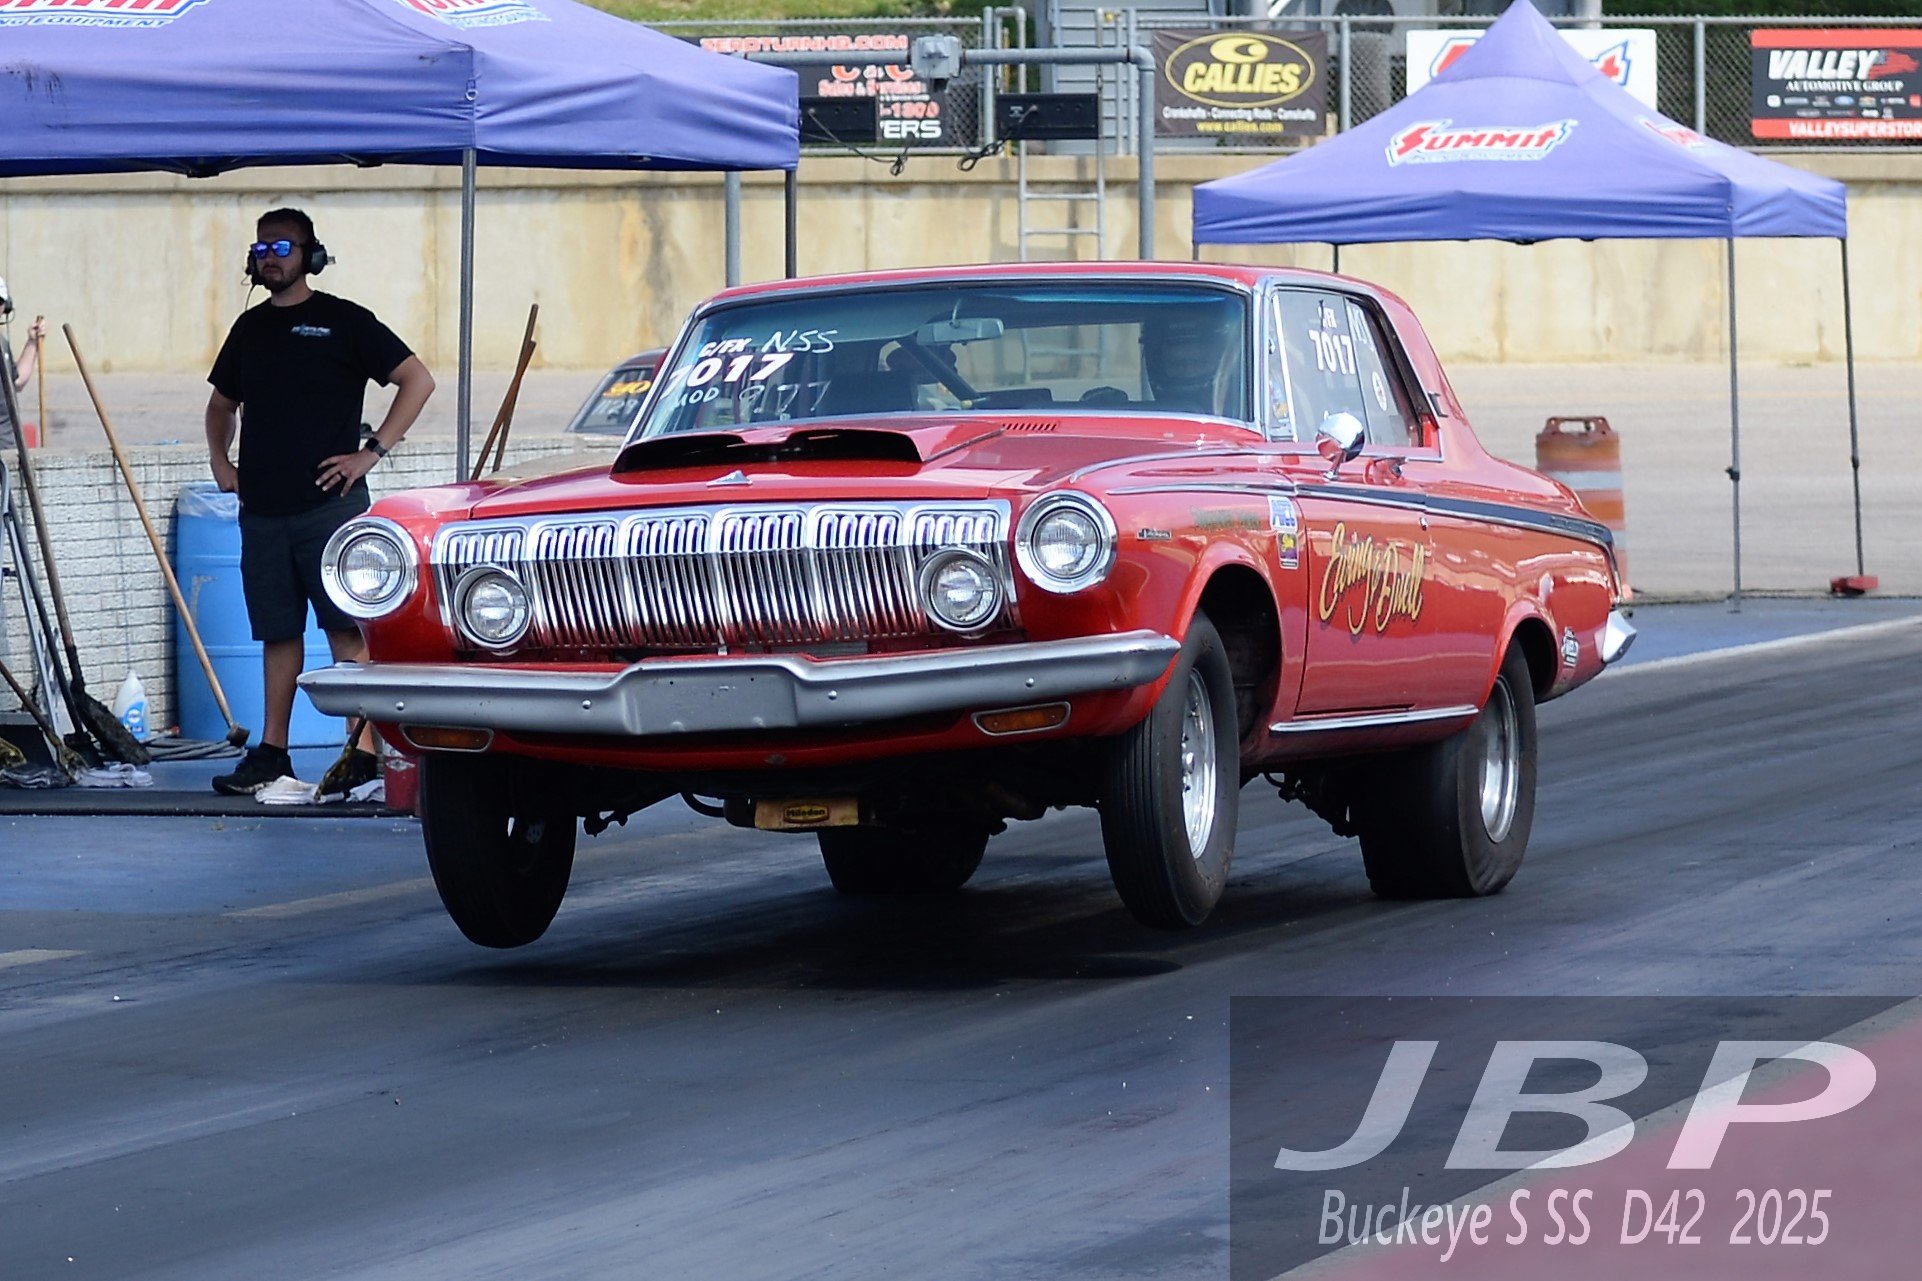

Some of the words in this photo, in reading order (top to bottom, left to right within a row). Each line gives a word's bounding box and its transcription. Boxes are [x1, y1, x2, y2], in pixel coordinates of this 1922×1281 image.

[1769, 49, 1879, 80] VALLEY
[1183, 62, 1300, 94] CALLIES
[1786, 80, 1861, 92] AUTOMOTIVE
[1862, 80, 1904, 92] GROUP
[881, 119, 942, 139] ERS
[761, 329, 838, 354] NSS
